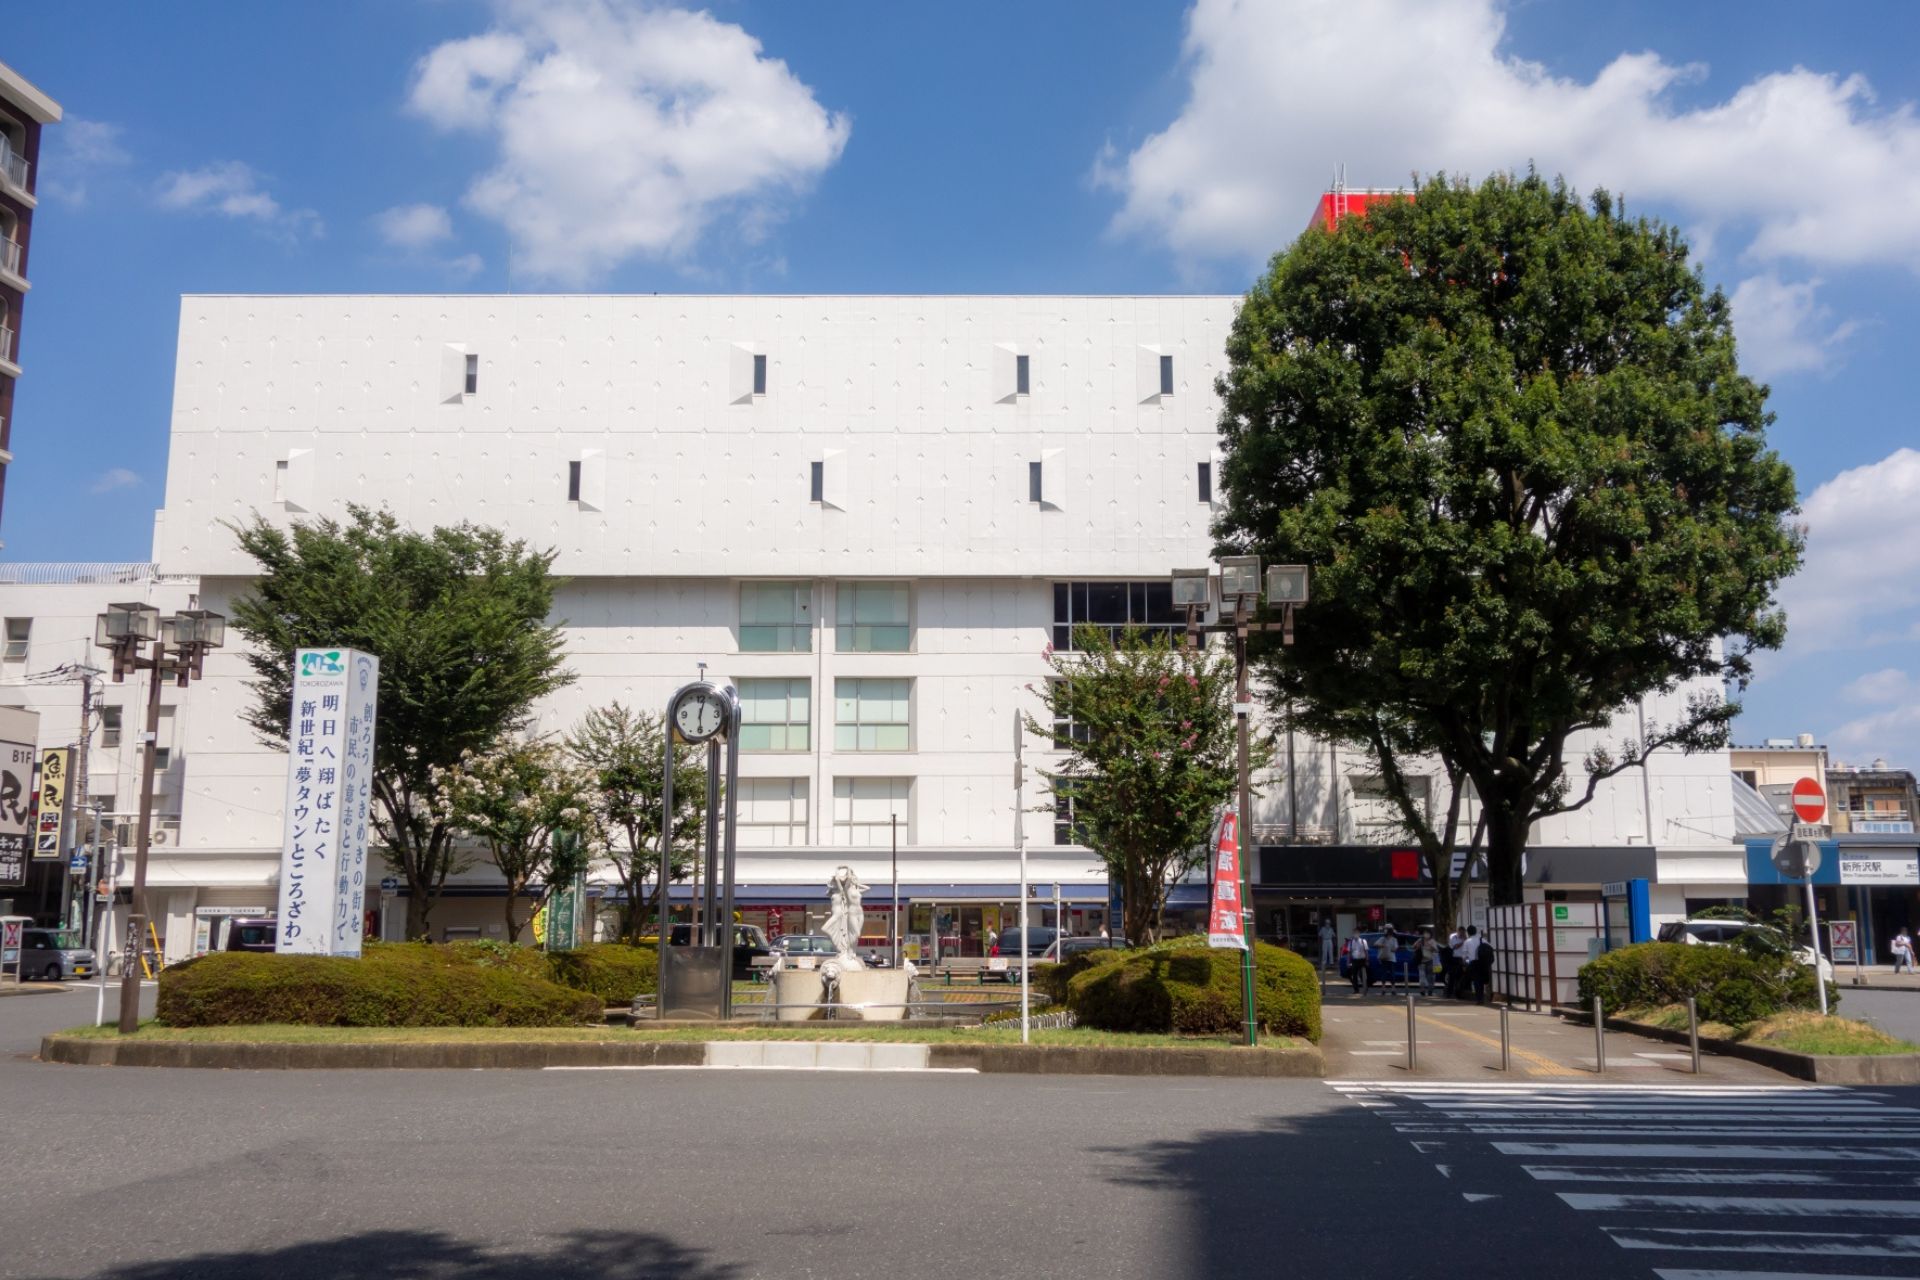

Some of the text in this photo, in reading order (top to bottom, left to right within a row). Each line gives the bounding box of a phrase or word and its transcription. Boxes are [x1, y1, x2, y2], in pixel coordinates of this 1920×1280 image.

[681, 711, 688, 719] 9
[714, 710, 720, 719] 3
[12, 749, 32, 765] B1F
[44, 752, 65, 807] 魚民
[314, 694, 339, 859] 明日へ翔ばたく
[1842, 861, 1882, 873] 新所沢駅
